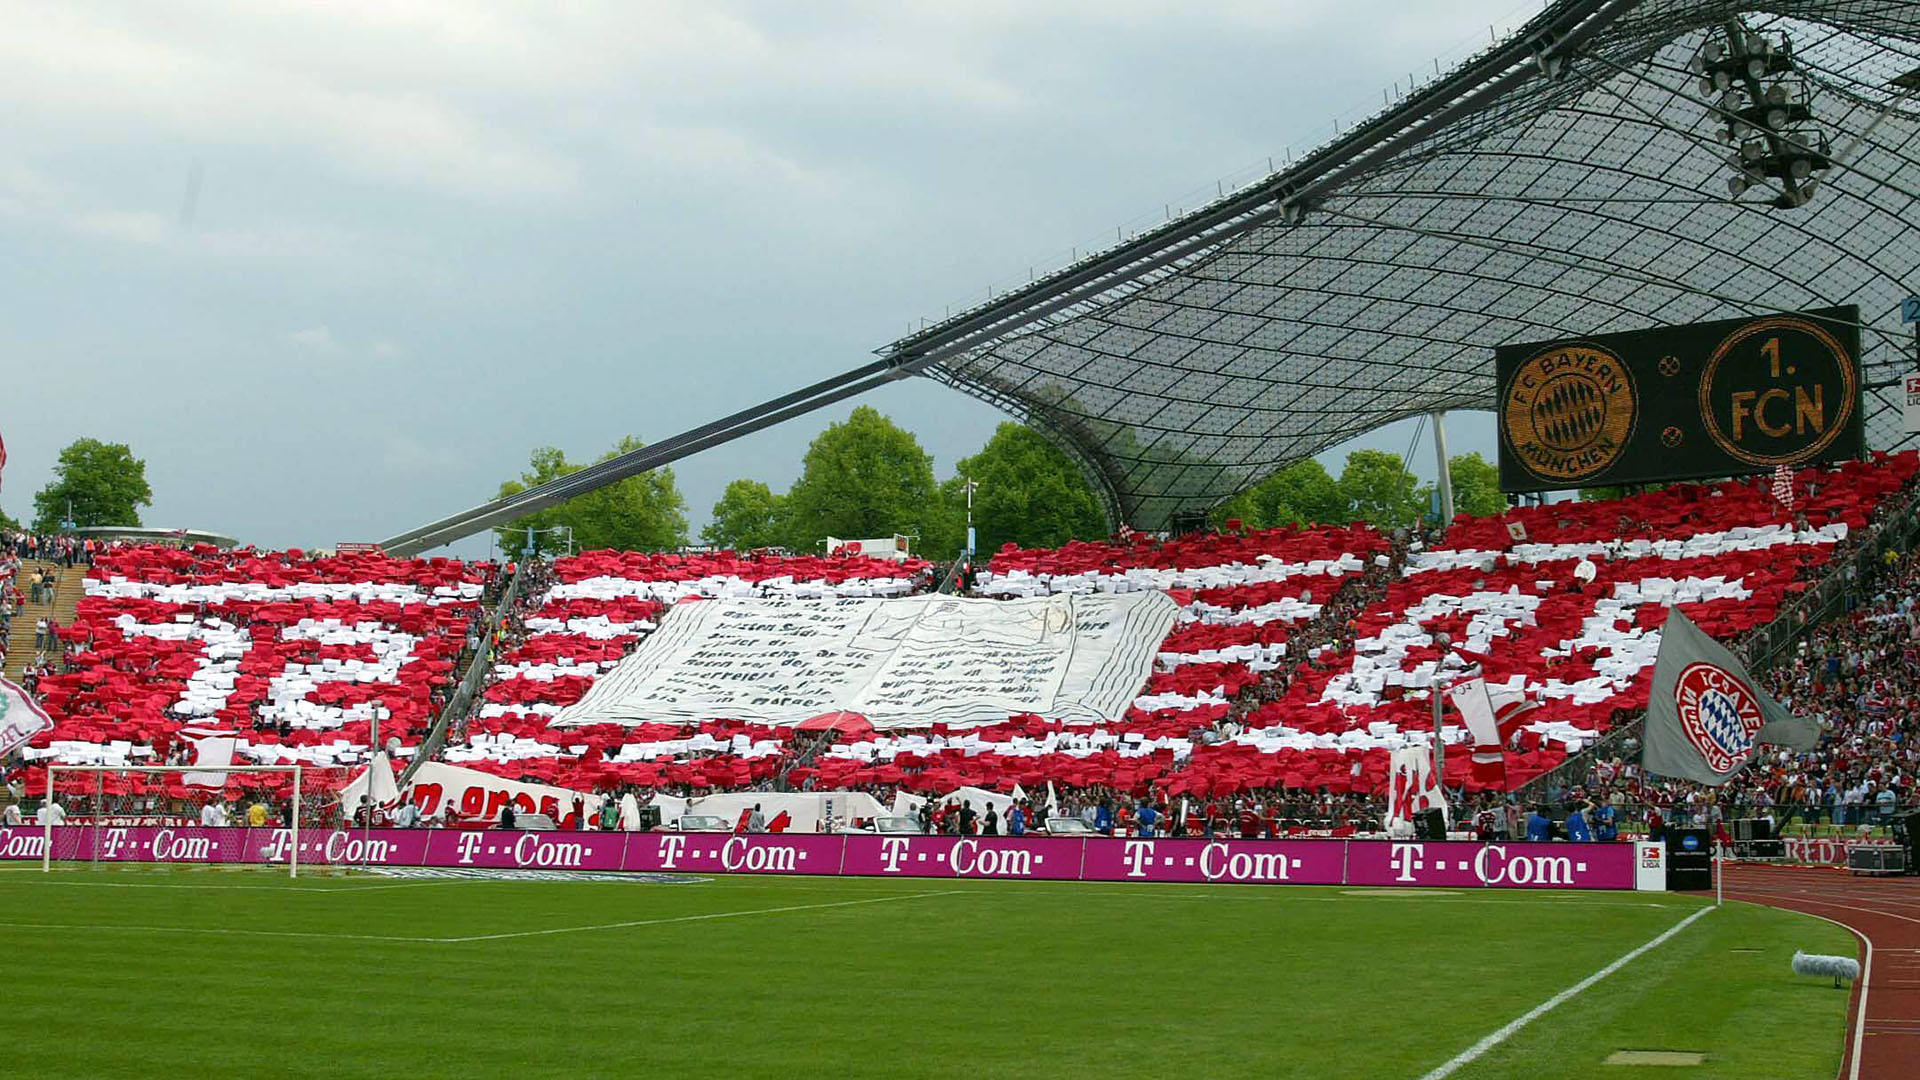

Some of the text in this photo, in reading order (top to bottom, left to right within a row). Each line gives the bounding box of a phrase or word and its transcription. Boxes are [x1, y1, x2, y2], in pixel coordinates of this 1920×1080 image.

[1513, 352, 1623, 405] FC BAYERN
[1760, 337, 1797, 378] 1.
[1731, 383, 1825, 441] FCN
[1522, 437, 1616, 474] MÜNCHEN
